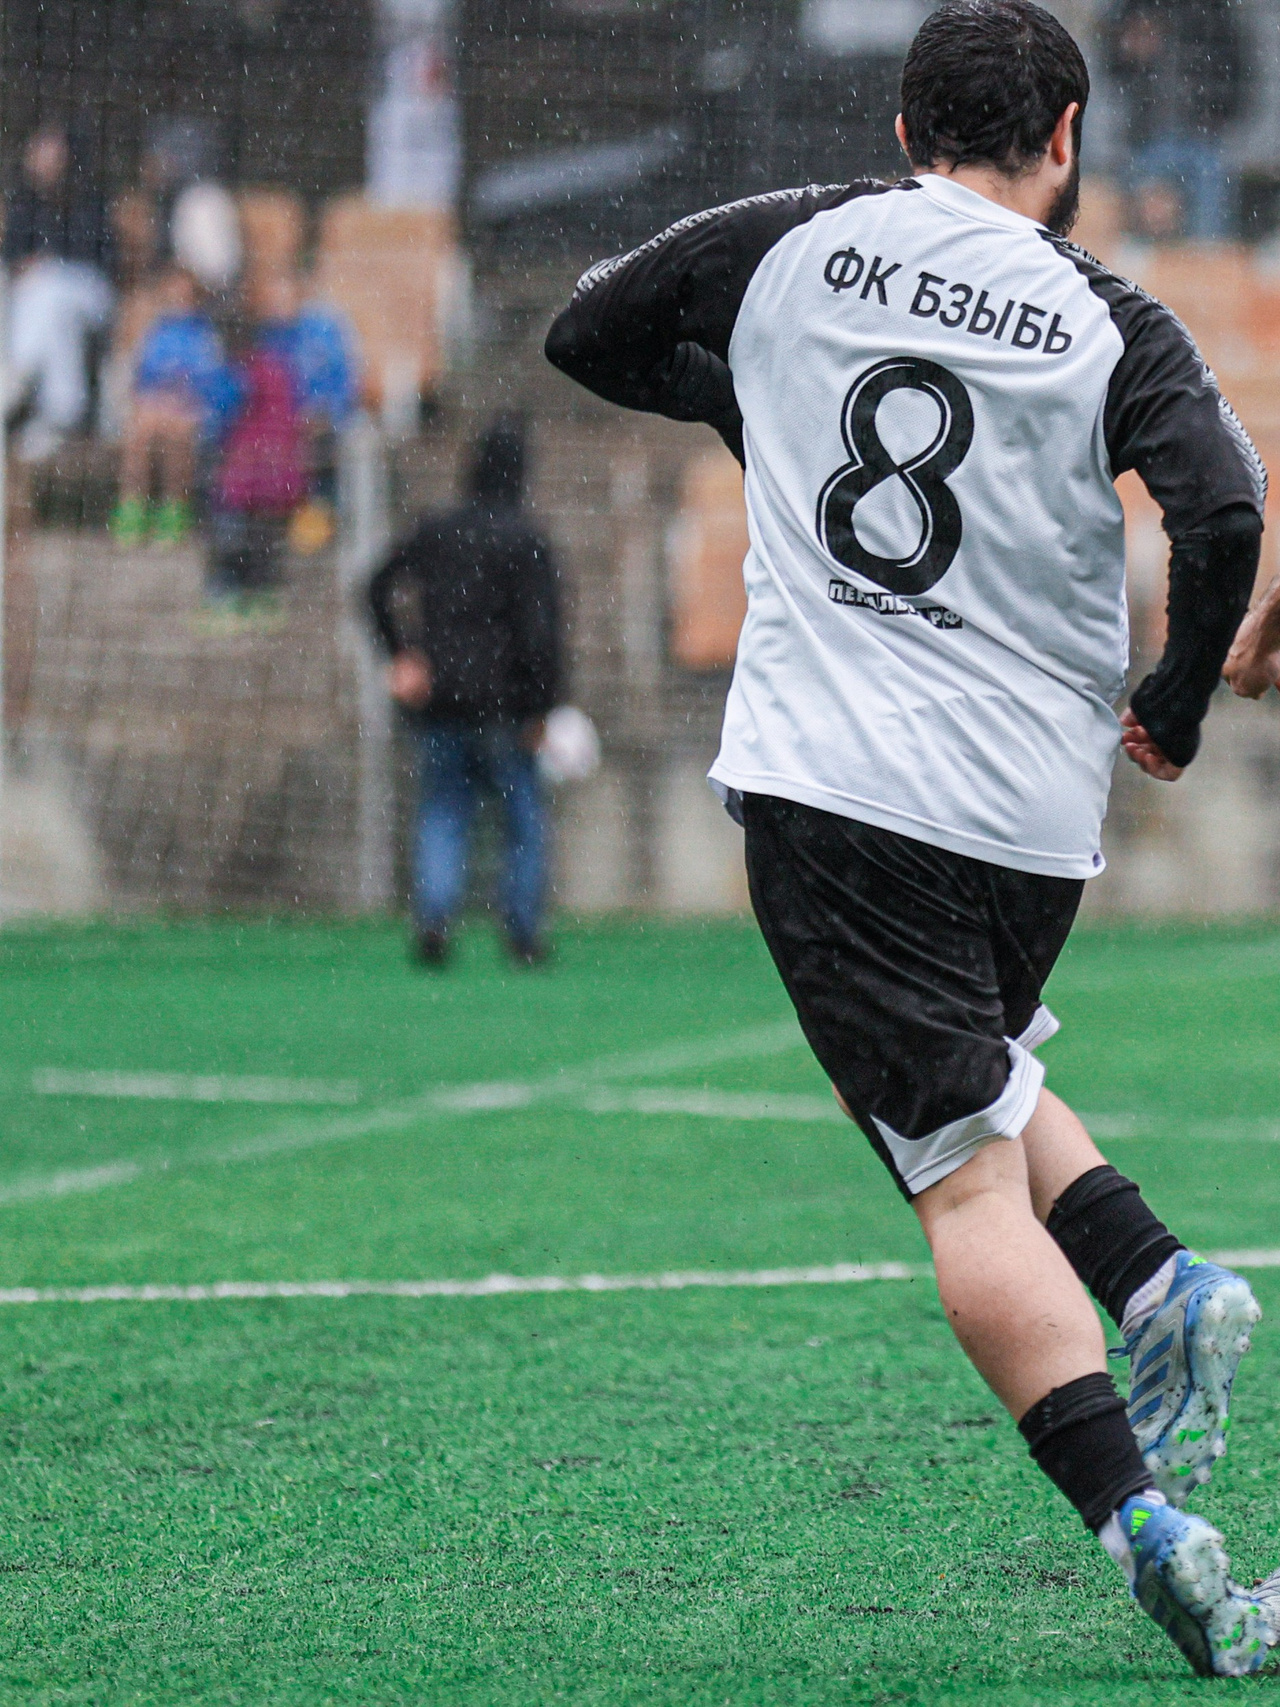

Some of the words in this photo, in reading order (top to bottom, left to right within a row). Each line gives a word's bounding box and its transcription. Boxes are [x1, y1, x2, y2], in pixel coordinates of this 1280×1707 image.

[823, 246, 903, 306] ФК
[909, 271, 1073, 355] БЗЫБЬ
[815, 356, 975, 597] 8
